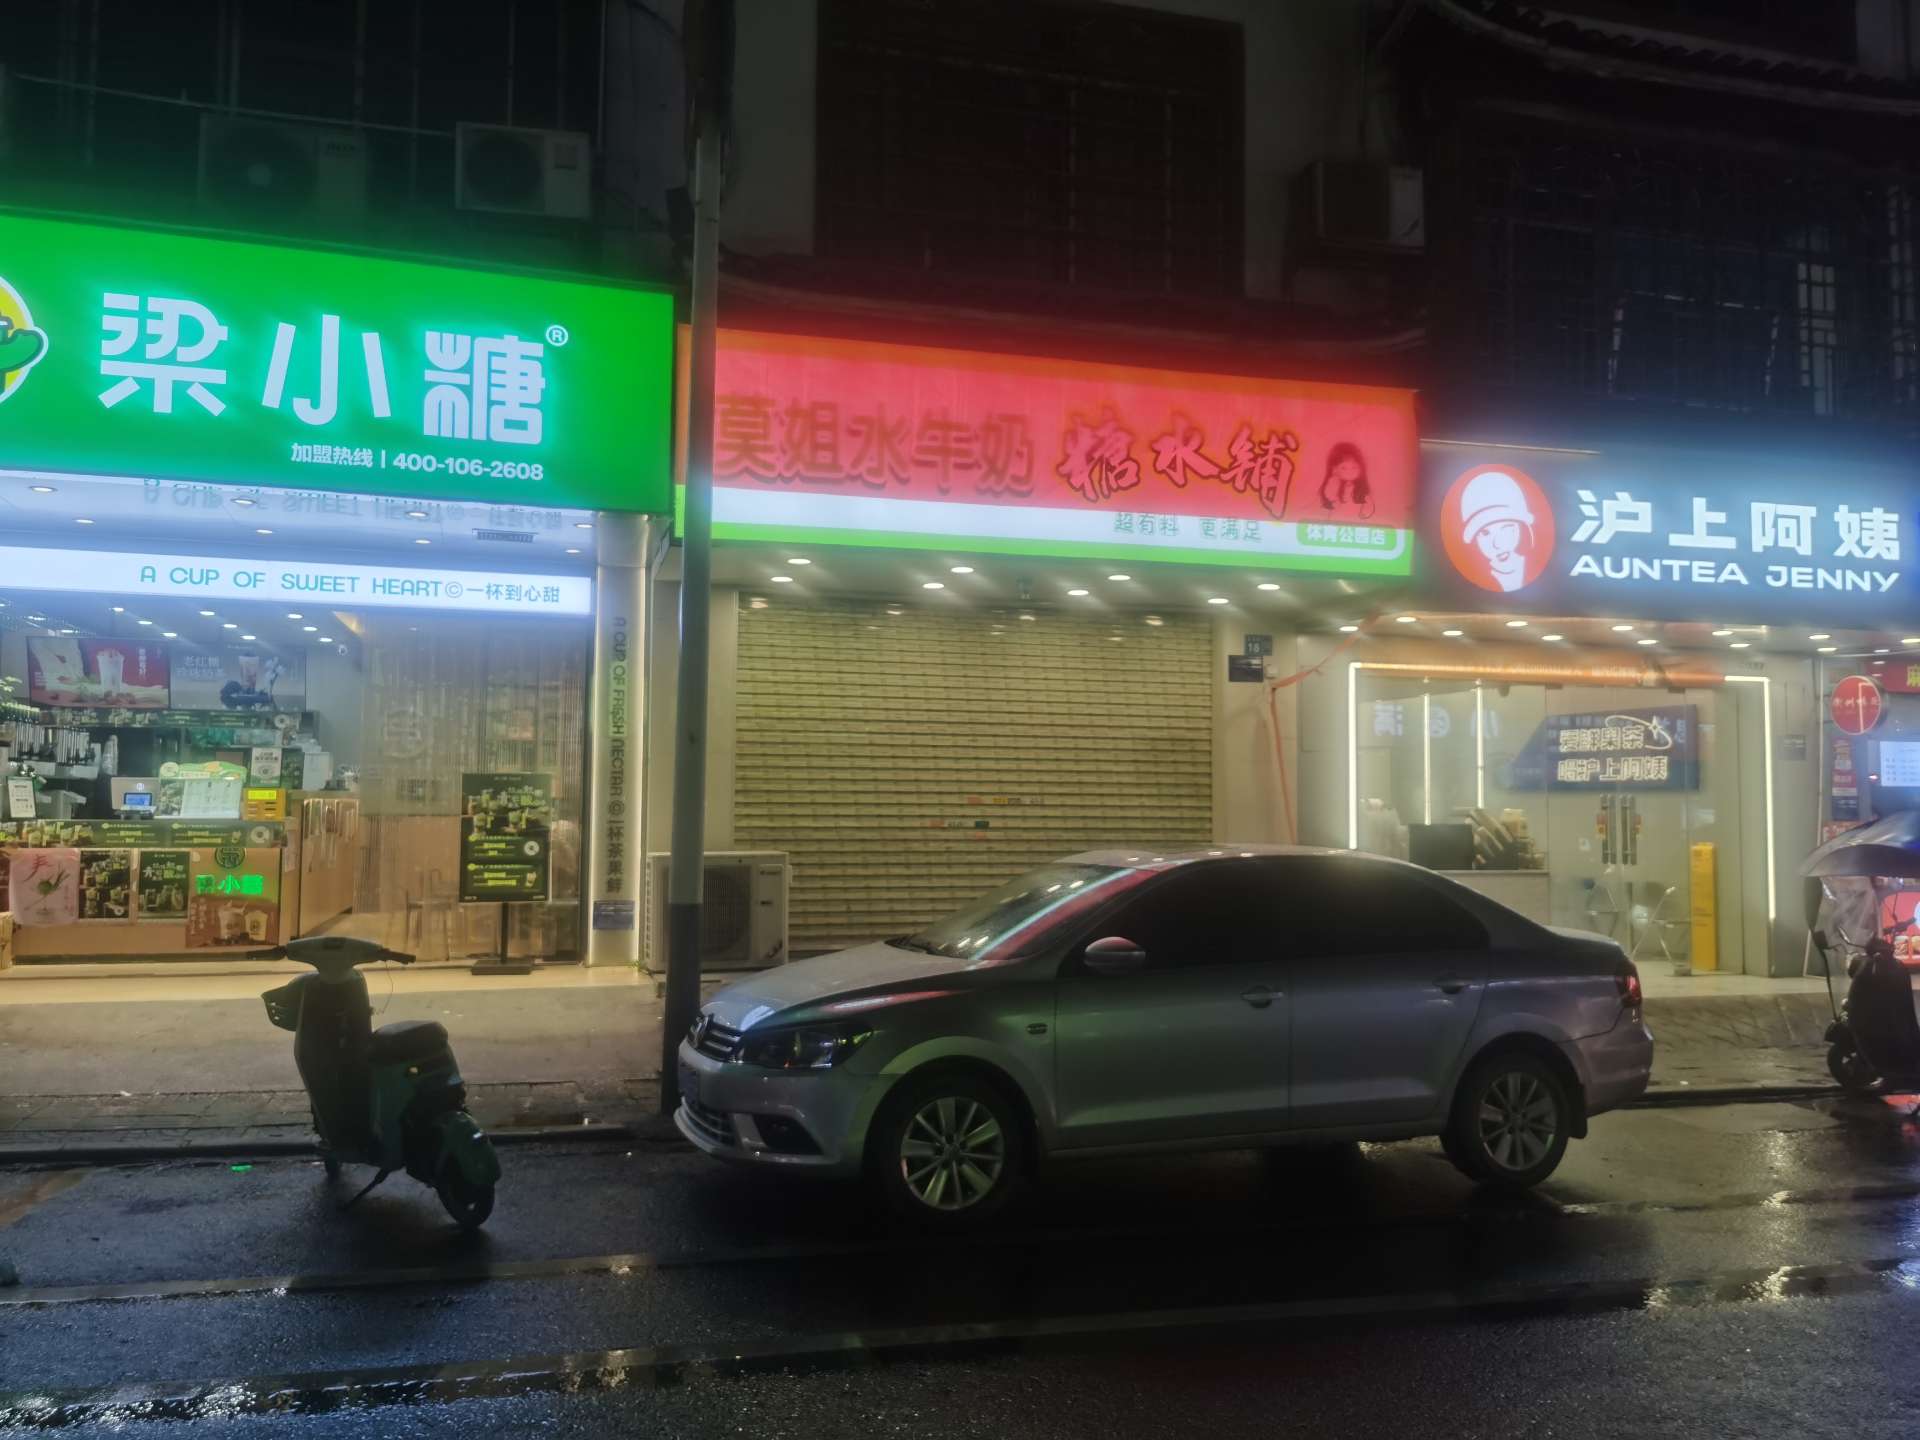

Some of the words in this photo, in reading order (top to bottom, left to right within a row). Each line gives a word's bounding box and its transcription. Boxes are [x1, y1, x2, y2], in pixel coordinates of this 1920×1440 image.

[98, 291, 546, 445] 梁小糖
[291, 443, 373, 468] 加盟热线
[393, 453, 544, 481] 400-106-2608
[714, 394, 1034, 497] 莫姐水牛奶
[1570, 489, 1901, 561] 沪上阿姨
[140, 566, 157, 584] A
[169, 566, 220, 586] CUP
[233, 571, 267, 589] OF
[281, 574, 361, 594] SWEET
[372, 578, 443, 598] HEART
[466, 583, 561, 604] 一杯到心甜
[1569, 555, 1749, 586] AUNTEA
[1765, 565, 1900, 593] JENNY
